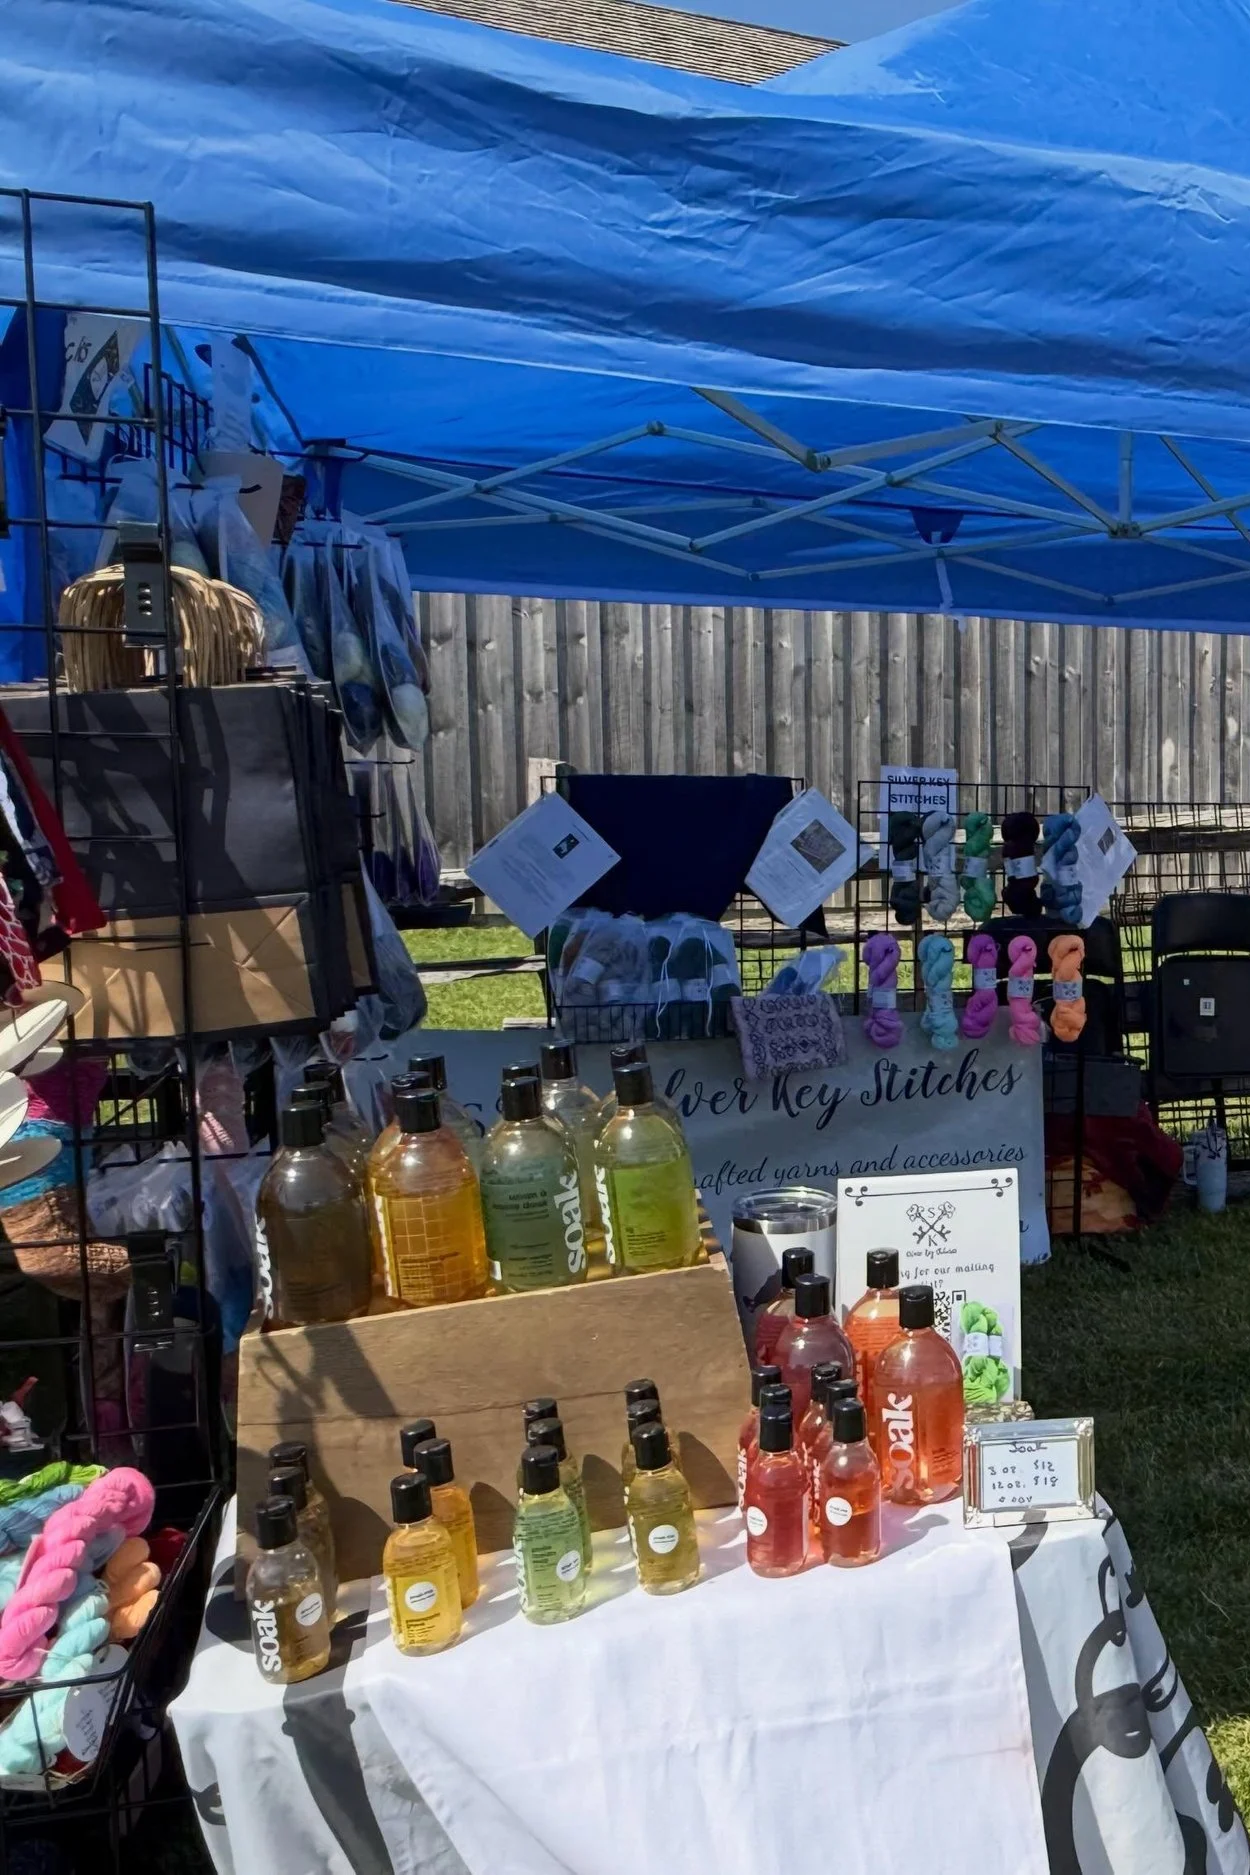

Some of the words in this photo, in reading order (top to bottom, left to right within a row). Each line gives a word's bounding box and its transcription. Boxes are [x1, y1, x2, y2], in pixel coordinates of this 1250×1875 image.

[887, 775, 928, 787] SILVER
[929, 776, 950, 787] KEY
[890, 793, 946, 805] STITCHES
[664, 1068, 758, 1118] lver
[772, 1069, 851, 1131] Key
[860, 1048, 1023, 1107] Stitches
[774, 1160, 842, 1188] yarns
[850, 1145, 897, 1174] and
[904, 1144, 1026, 1170] accessories
[554, 1169, 587, 1274] soak
[914, 1266, 930, 1280] for
[934, 1266, 950, 1275] our
[882, 1391, 915, 1491] soak
[252, 1598, 282, 1673] soak
